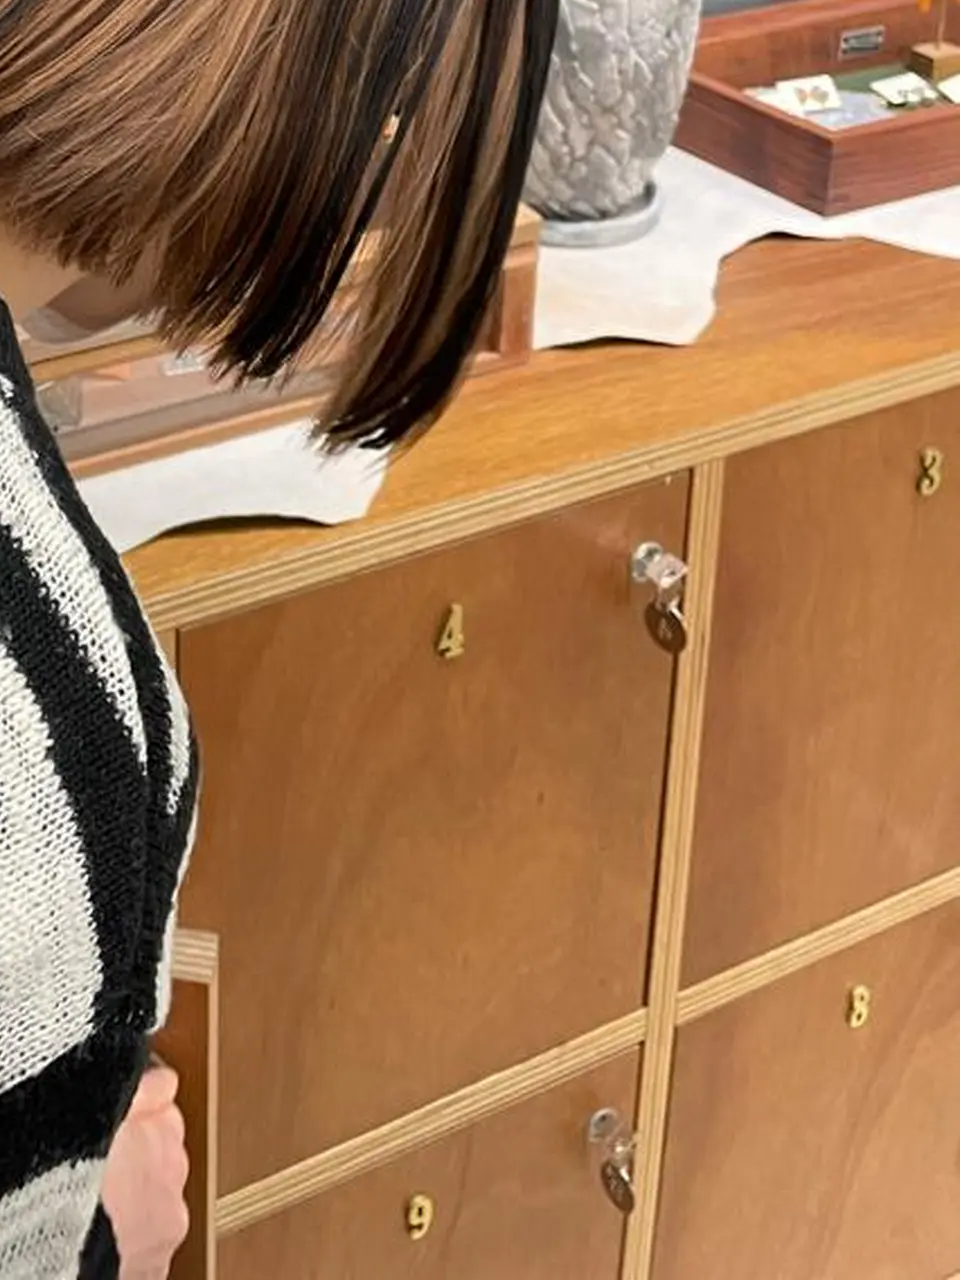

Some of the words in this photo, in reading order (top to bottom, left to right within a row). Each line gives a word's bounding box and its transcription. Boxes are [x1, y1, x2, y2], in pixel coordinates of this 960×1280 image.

[921, 446, 942, 496] 3
[438, 603, 464, 659] 4
[851, 984, 870, 1028] 8
[409, 1195, 432, 1239] 9
